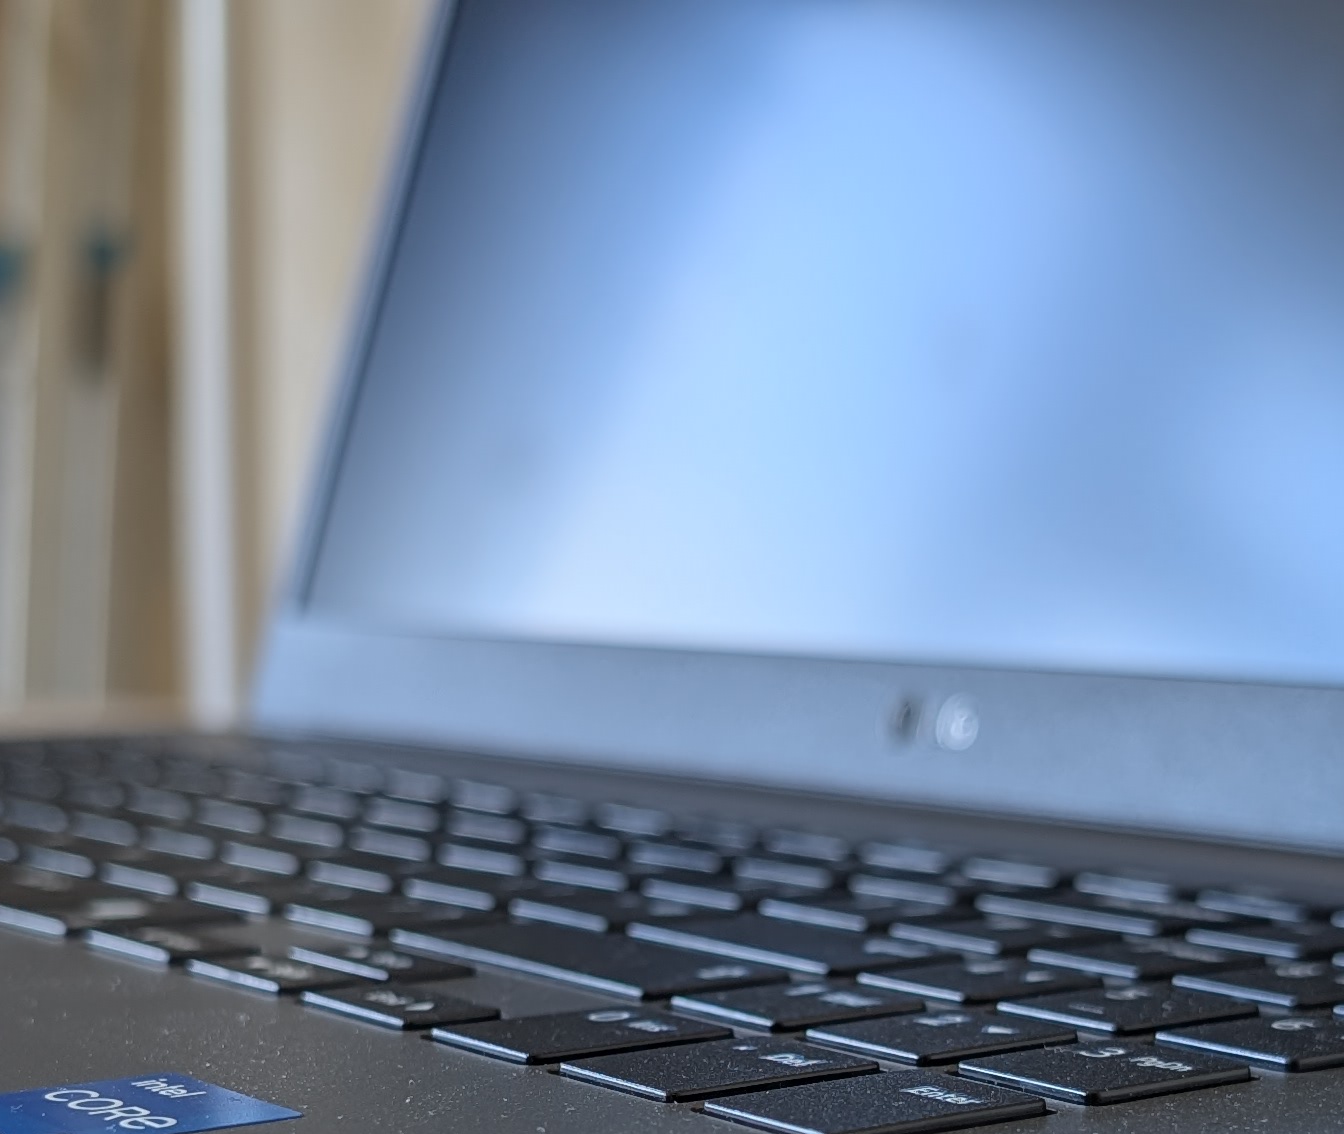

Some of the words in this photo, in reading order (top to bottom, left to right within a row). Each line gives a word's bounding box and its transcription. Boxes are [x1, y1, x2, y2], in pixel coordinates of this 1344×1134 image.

[1076, 1046, 1125, 1058] 3
[132, 1078, 206, 1099] intel
[899, 1085, 985, 1105] Enter
